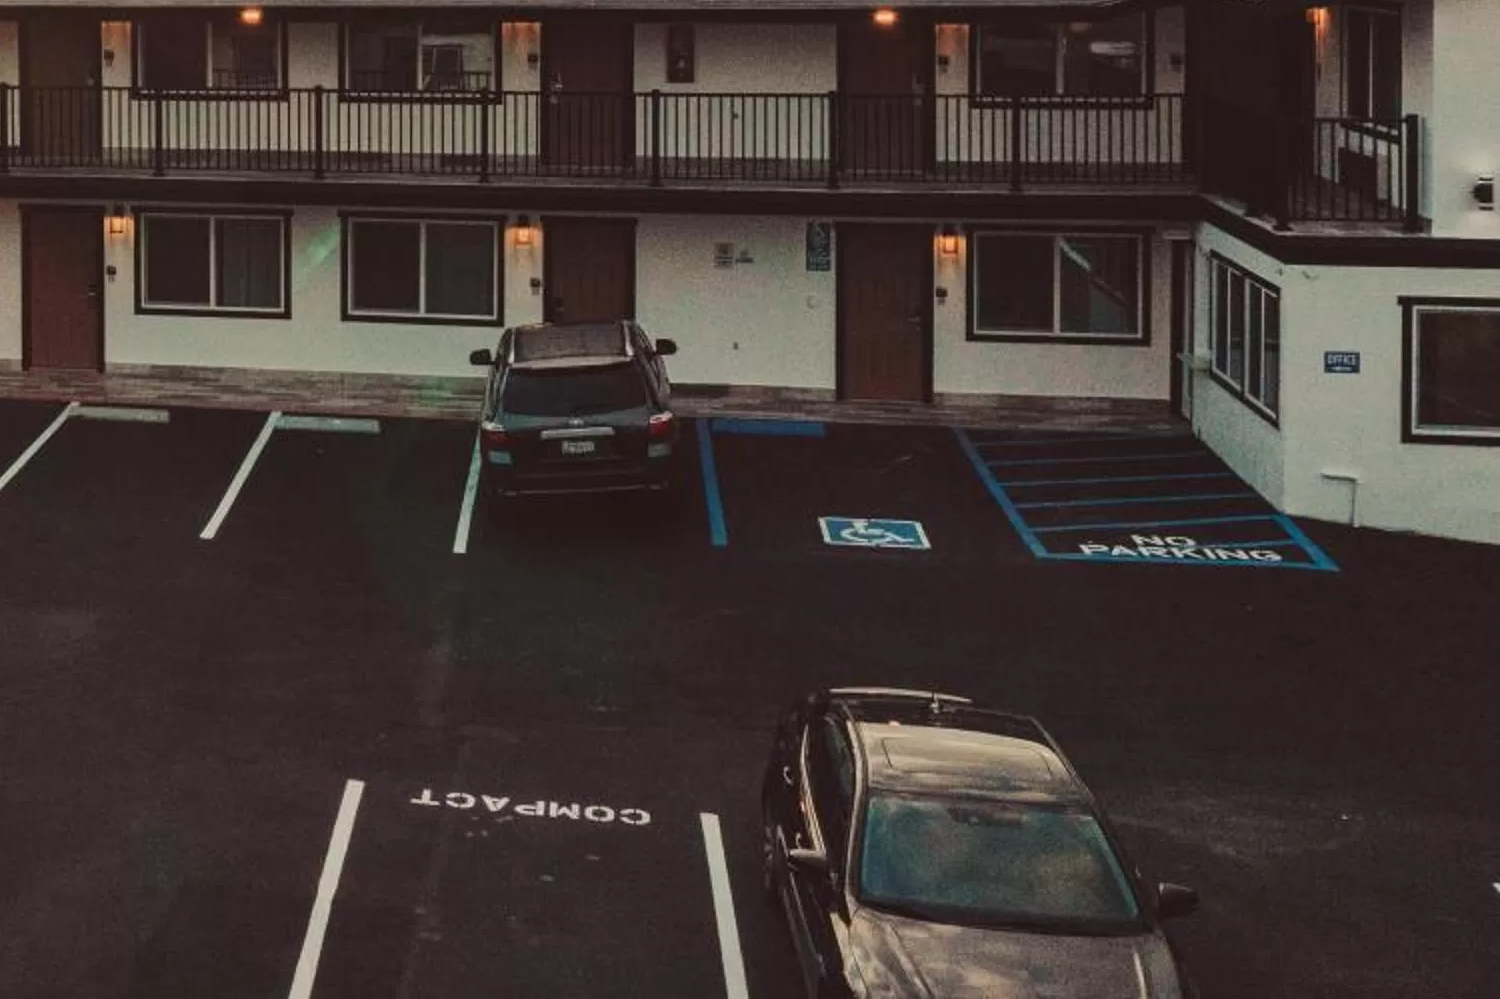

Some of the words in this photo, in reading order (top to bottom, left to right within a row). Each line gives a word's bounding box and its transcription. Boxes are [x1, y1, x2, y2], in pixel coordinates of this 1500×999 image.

[1131, 534, 1195, 547] NO
[1078, 544, 1282, 562] PARKING
[410, 789, 651, 825] COMPACT
